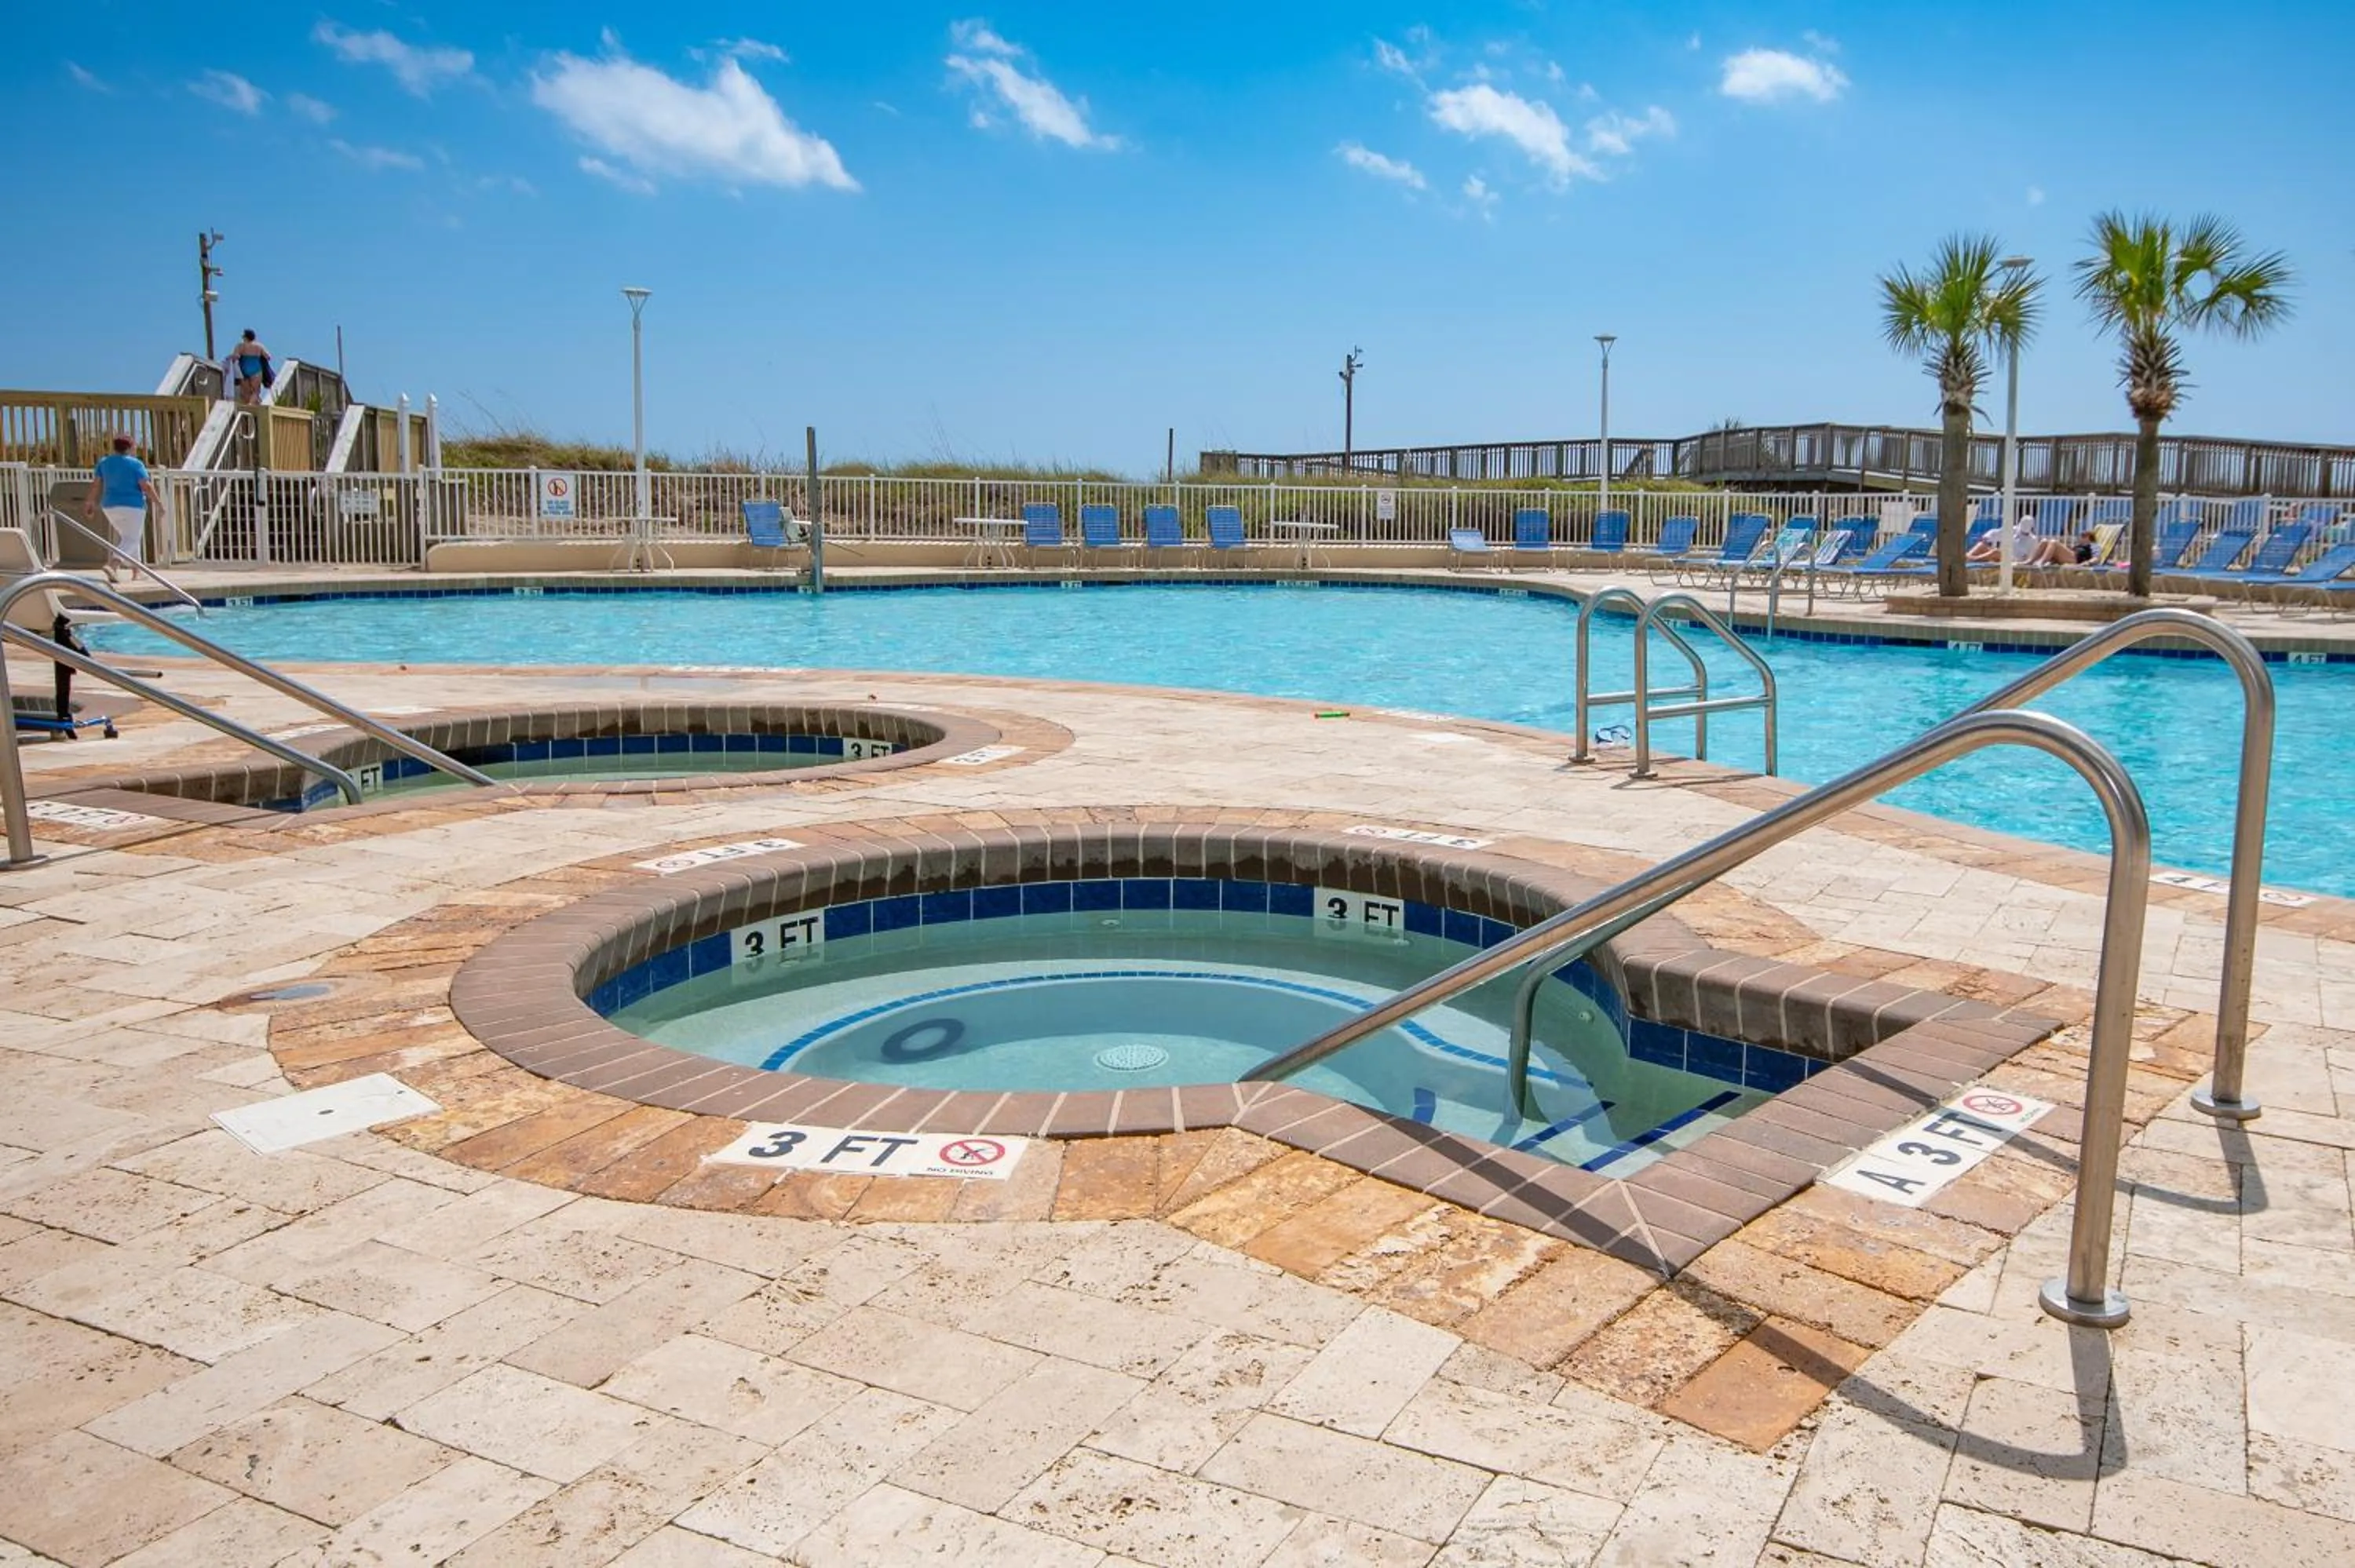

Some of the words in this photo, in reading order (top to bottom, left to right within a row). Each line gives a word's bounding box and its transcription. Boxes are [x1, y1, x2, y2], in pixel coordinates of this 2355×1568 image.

[851, 742, 862, 760] 3
[871, 744, 889, 758] FT
[360, 767, 380, 792] FT
[1327, 897, 1348, 920] 3
[1364, 901, 1400, 927] FT
[745, 931, 765, 958] 3
[780, 916, 819, 950] FT
[1922, 1111, 2005, 1147] FT
[748, 1131, 807, 1158] 3
[820, 1135, 918, 1167] FT
[1897, 1141, 1962, 1166] 3
[948, 1167, 994, 1176] DIVING
[1856, 1169, 1926, 1195] A
